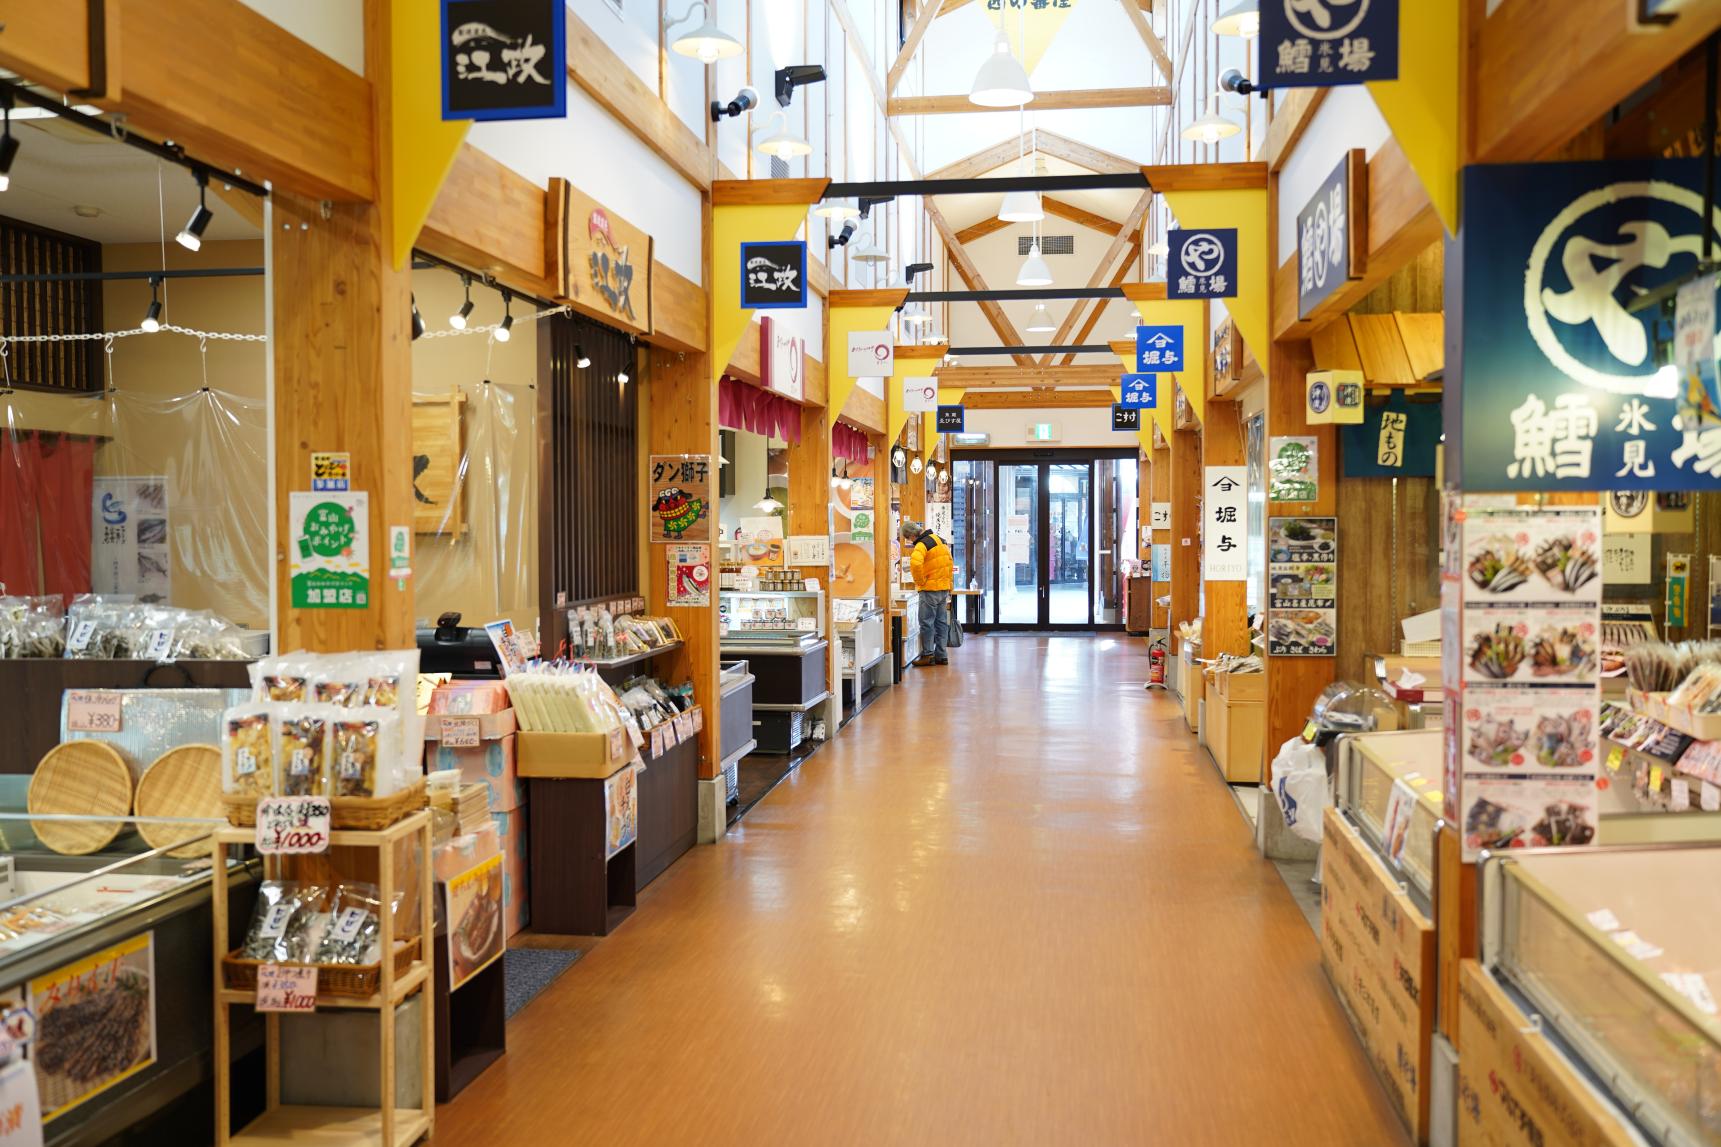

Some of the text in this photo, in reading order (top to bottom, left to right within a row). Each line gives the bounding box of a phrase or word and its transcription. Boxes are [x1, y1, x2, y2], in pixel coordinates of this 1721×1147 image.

[455, 33, 551, 85] 江政
[1318, 41, 1333, 72] 氷見
[1338, 37, 1376, 72] 場
[1115, 412, 1136, 423] こすけ
[1381, 414, 1404, 466] 地もの
[1615, 398, 1657, 478] 氷見
[653, 461, 708, 483] ダン獅子
[1215, 506, 1237, 552] 堀与
[306, 589, 353, 604] 加盟店
